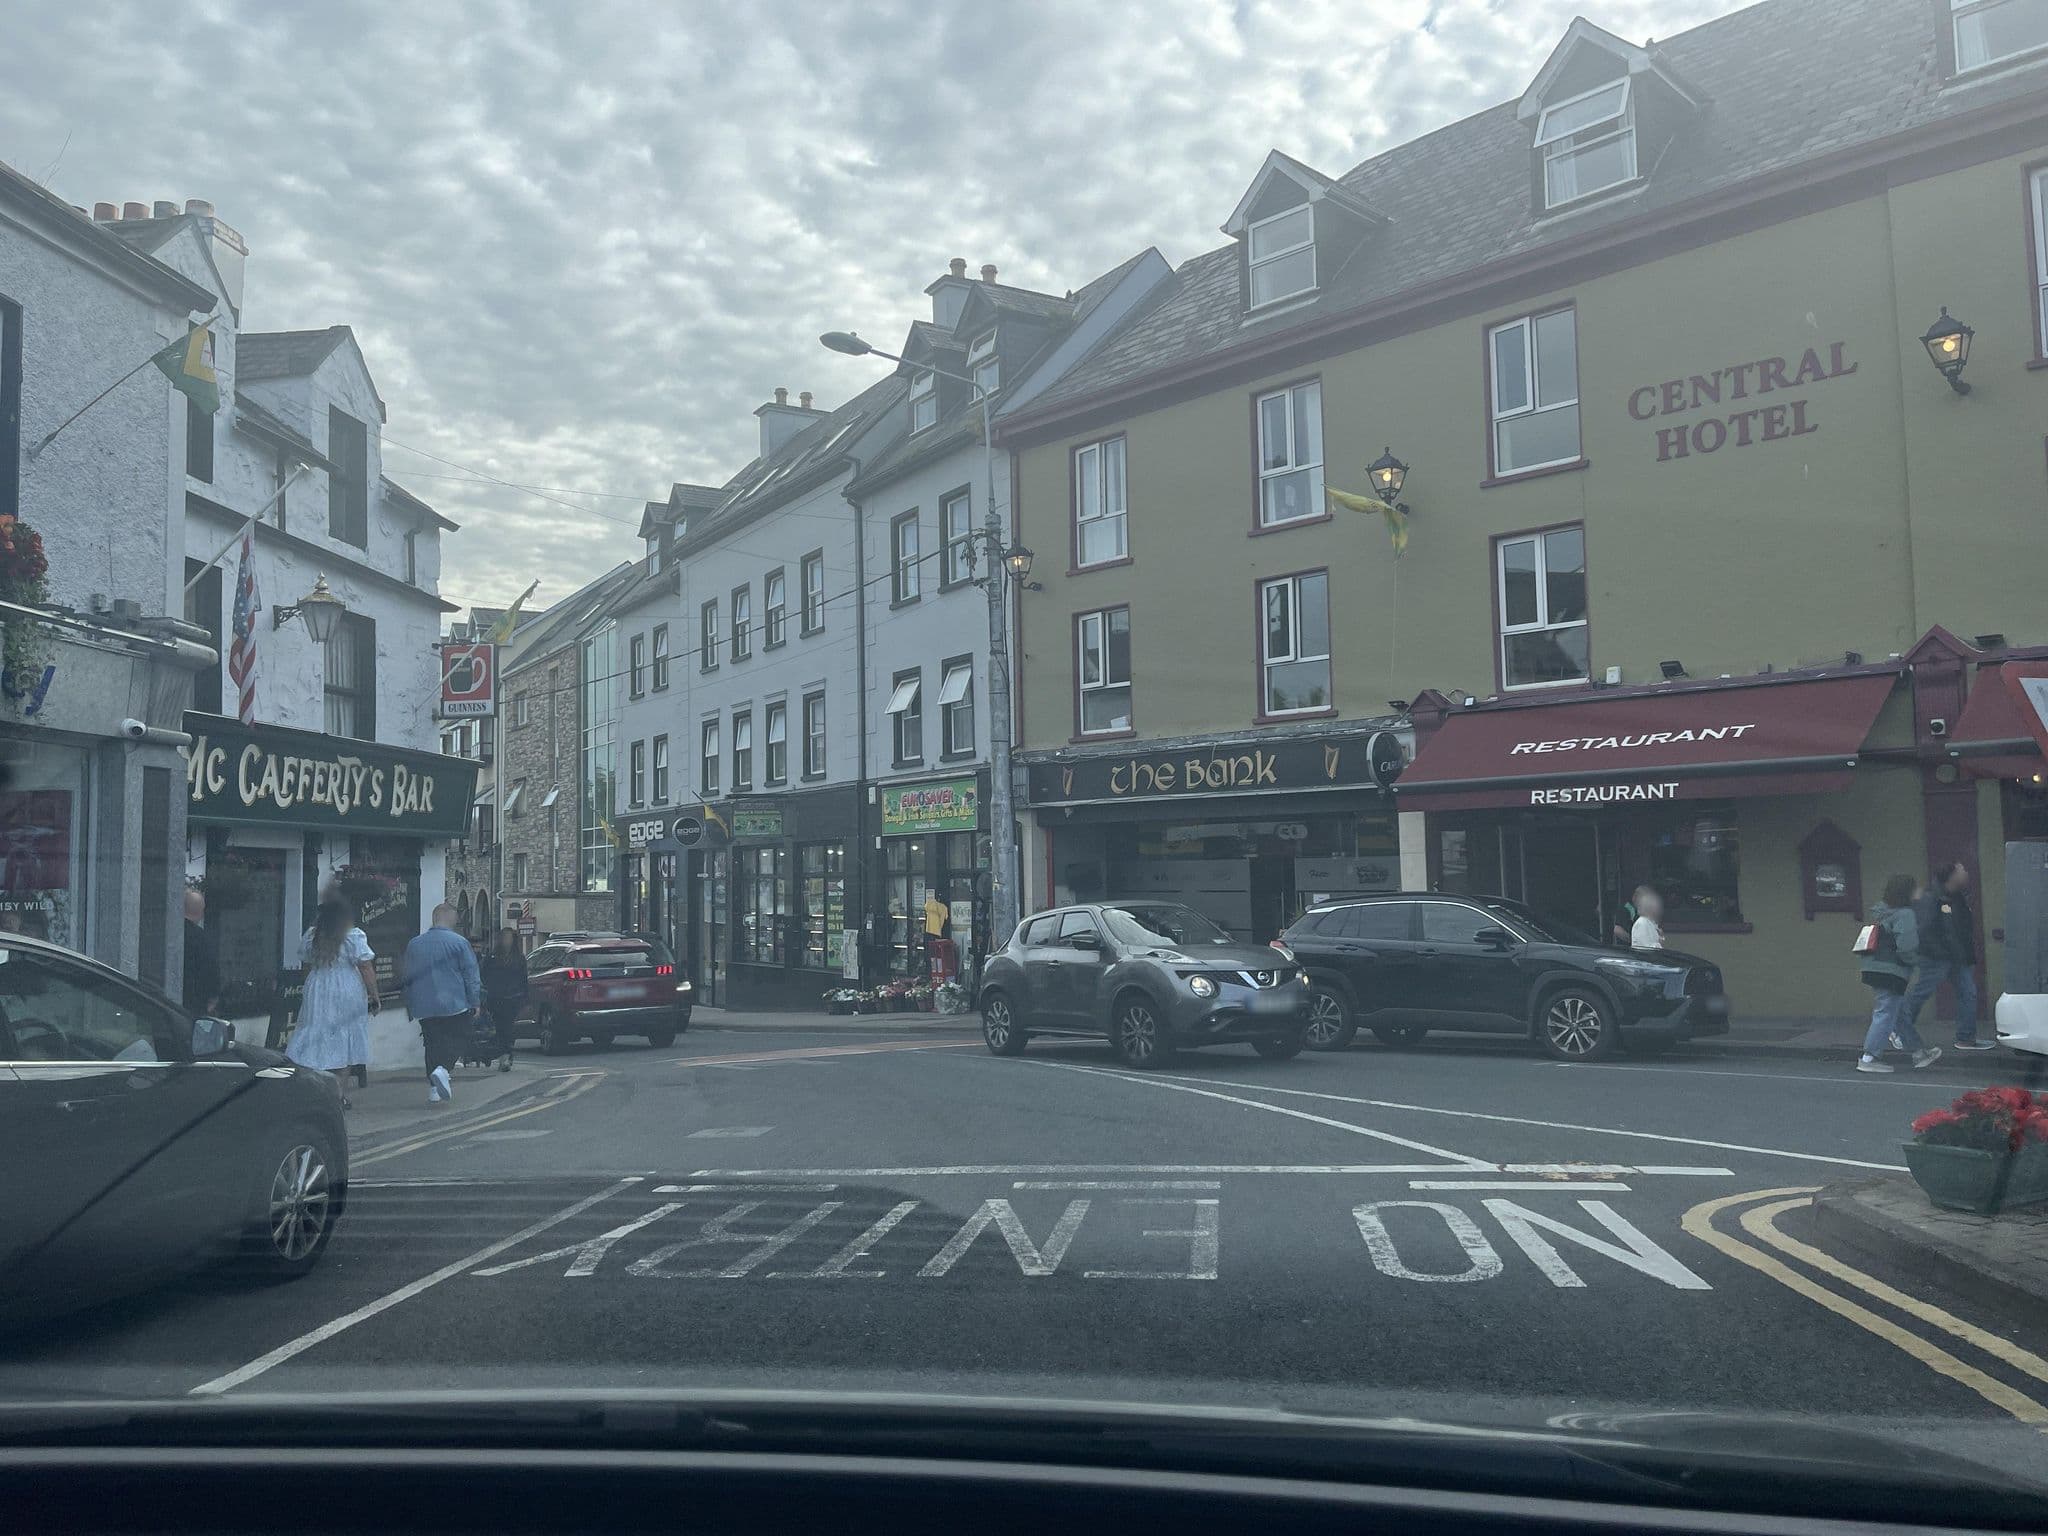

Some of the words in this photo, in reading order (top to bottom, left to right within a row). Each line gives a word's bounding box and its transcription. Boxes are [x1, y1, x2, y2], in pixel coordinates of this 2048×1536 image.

[1627, 341, 1858, 420] CENTRAL
[1656, 400, 1819, 462] HOTEL
[448, 702, 487, 713] GUINNESS
[1509, 723, 1756, 755] RESTAURANT
[1530, 782, 1680, 805] RESTAURANT
[471, 1197, 1220, 1281] ENTRY
[1352, 1198, 1712, 1290] NO
